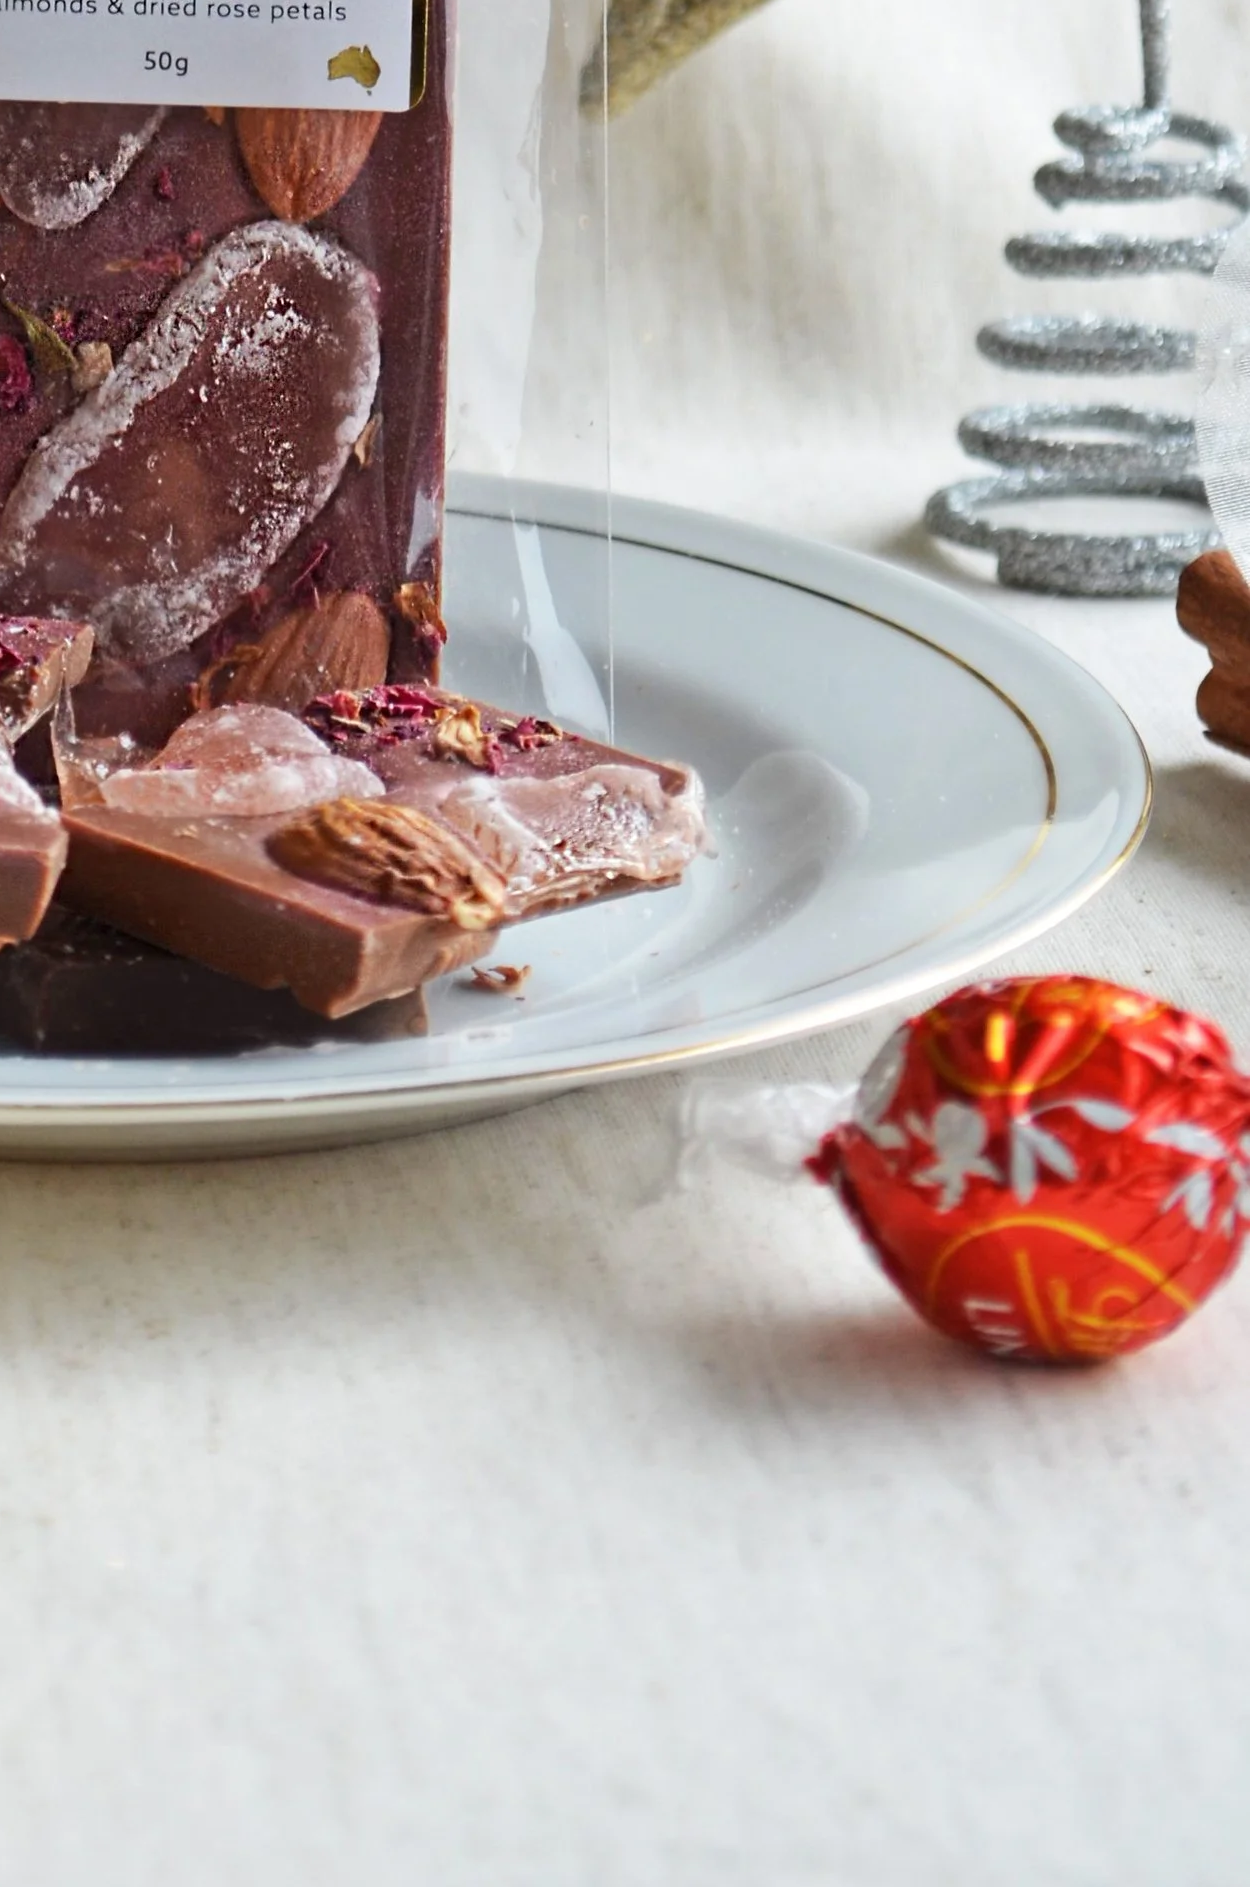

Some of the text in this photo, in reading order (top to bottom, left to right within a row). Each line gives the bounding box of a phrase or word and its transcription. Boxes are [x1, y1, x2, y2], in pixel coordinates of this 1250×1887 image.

[206, 2, 262, 19] rose
[270, 0, 348, 25] petals
[143, 50, 189, 77] 50g
